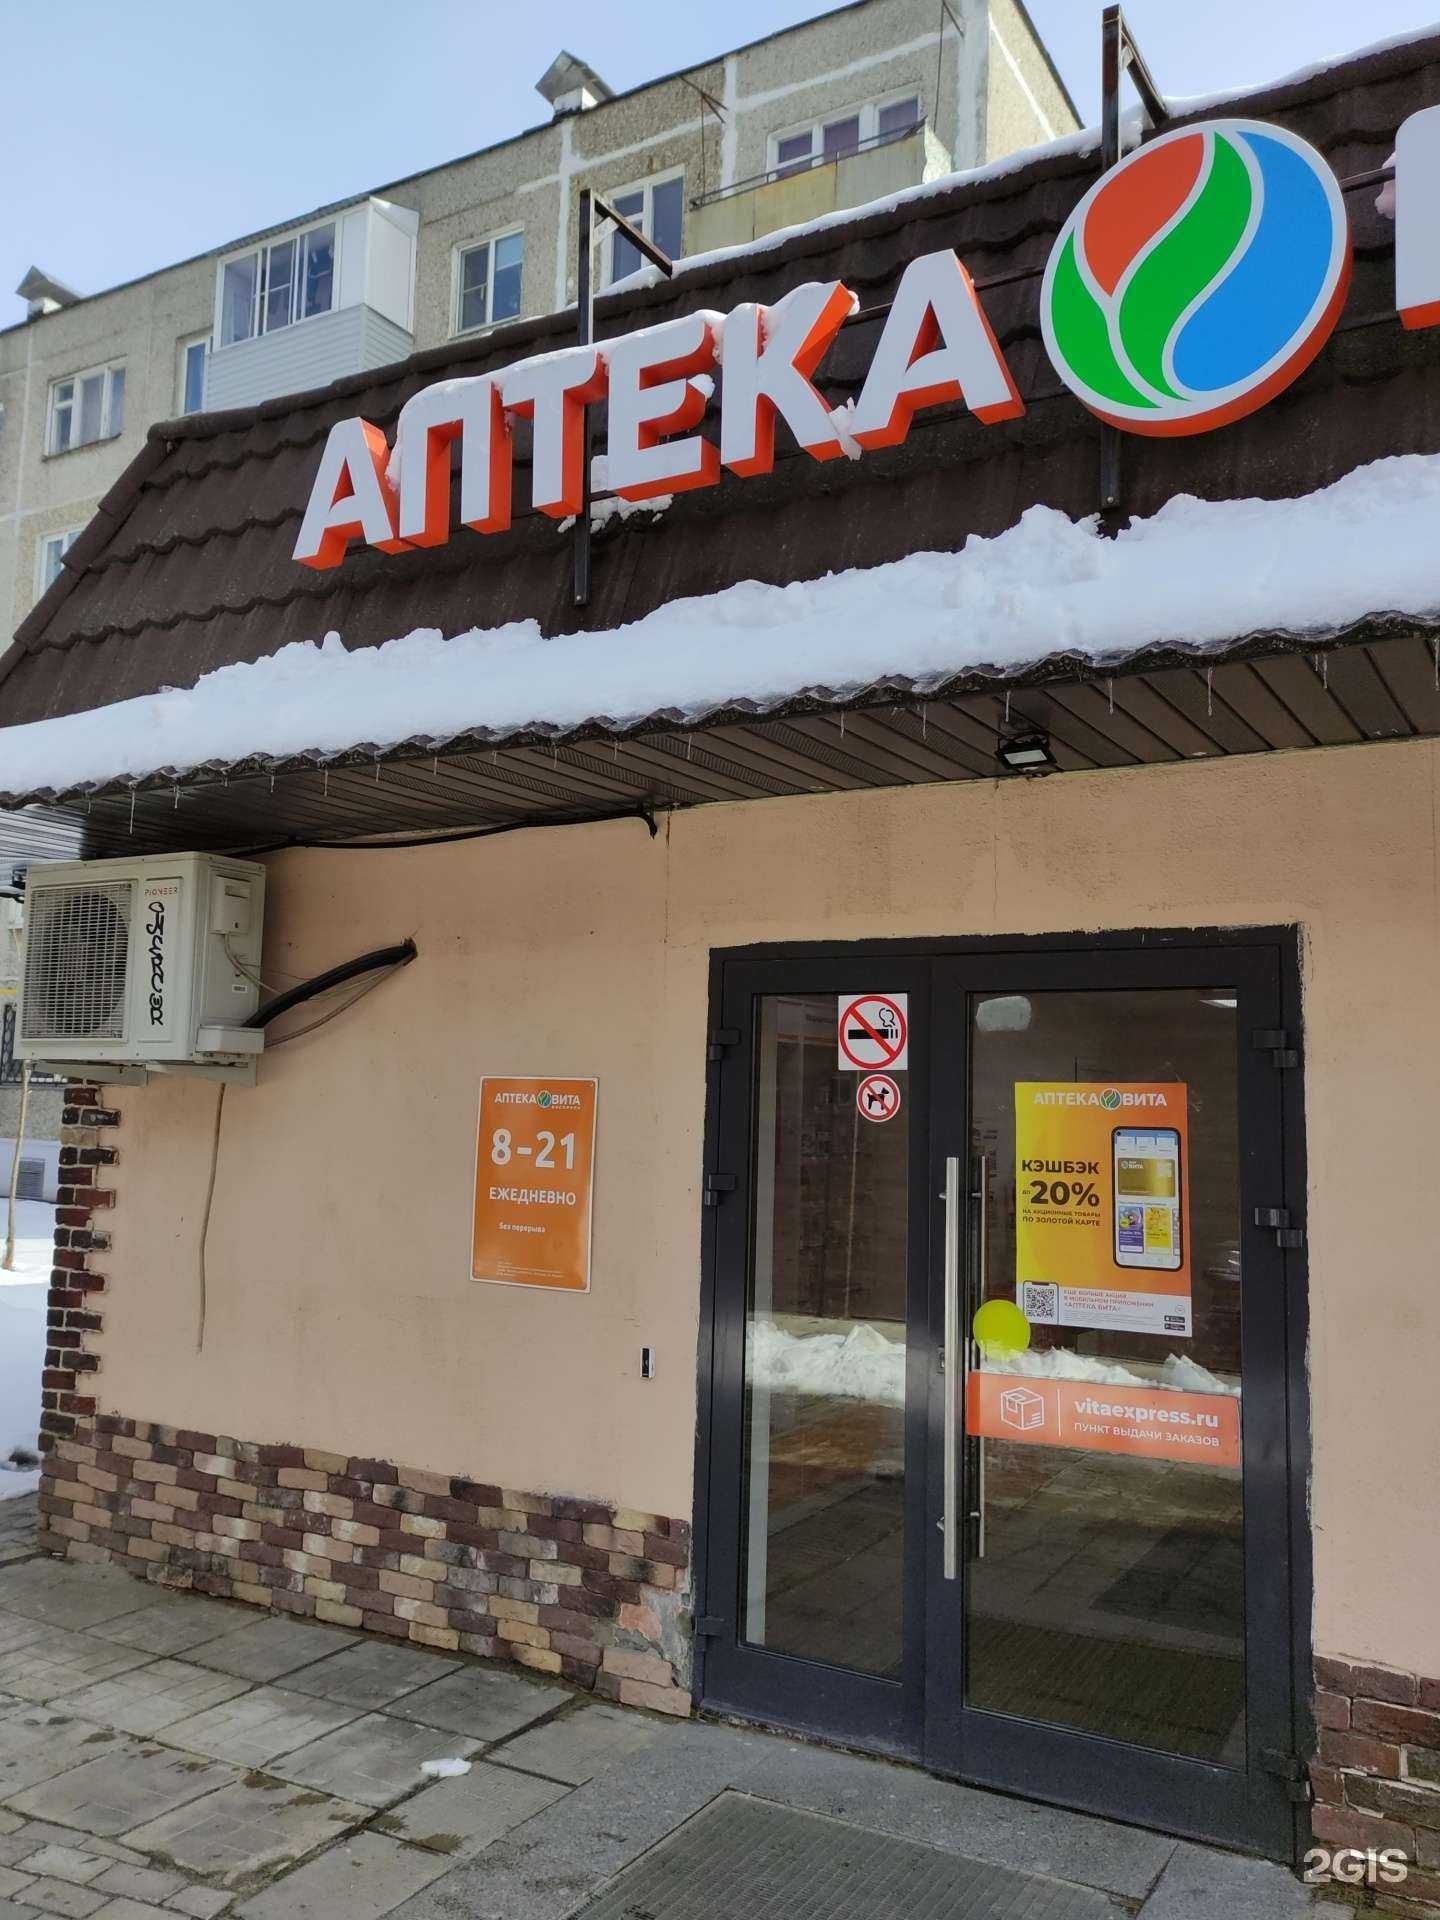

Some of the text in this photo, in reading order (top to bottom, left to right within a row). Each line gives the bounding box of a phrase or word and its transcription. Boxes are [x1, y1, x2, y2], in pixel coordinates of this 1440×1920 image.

[292, 248, 1025, 570] АПТЕКА
[145, 887, 177, 896] PIONEER
[494, 1092, 581, 1106] АПТЕКА ВИТА
[1034, 1092, 1168, 1107] АПТЕКА ВИТА
[1021, 1159, 1100, 1175] КЭШБЭК
[489, 1187, 577, 1206] ЕЖЕДНЕВНО
[1030, 1180, 1100, 1207] 20%
[1035, 1217, 1074, 1225] ЗОЛОТОЙ
[1075, 1219, 1100, 1227] КАРТЕ
[1074, 1398, 1218, 1428] vitaexpress.ru
[1074, 1422, 1220, 1447] ПУНКТ ВЫДАЧИ ЗАКАЗОВ
